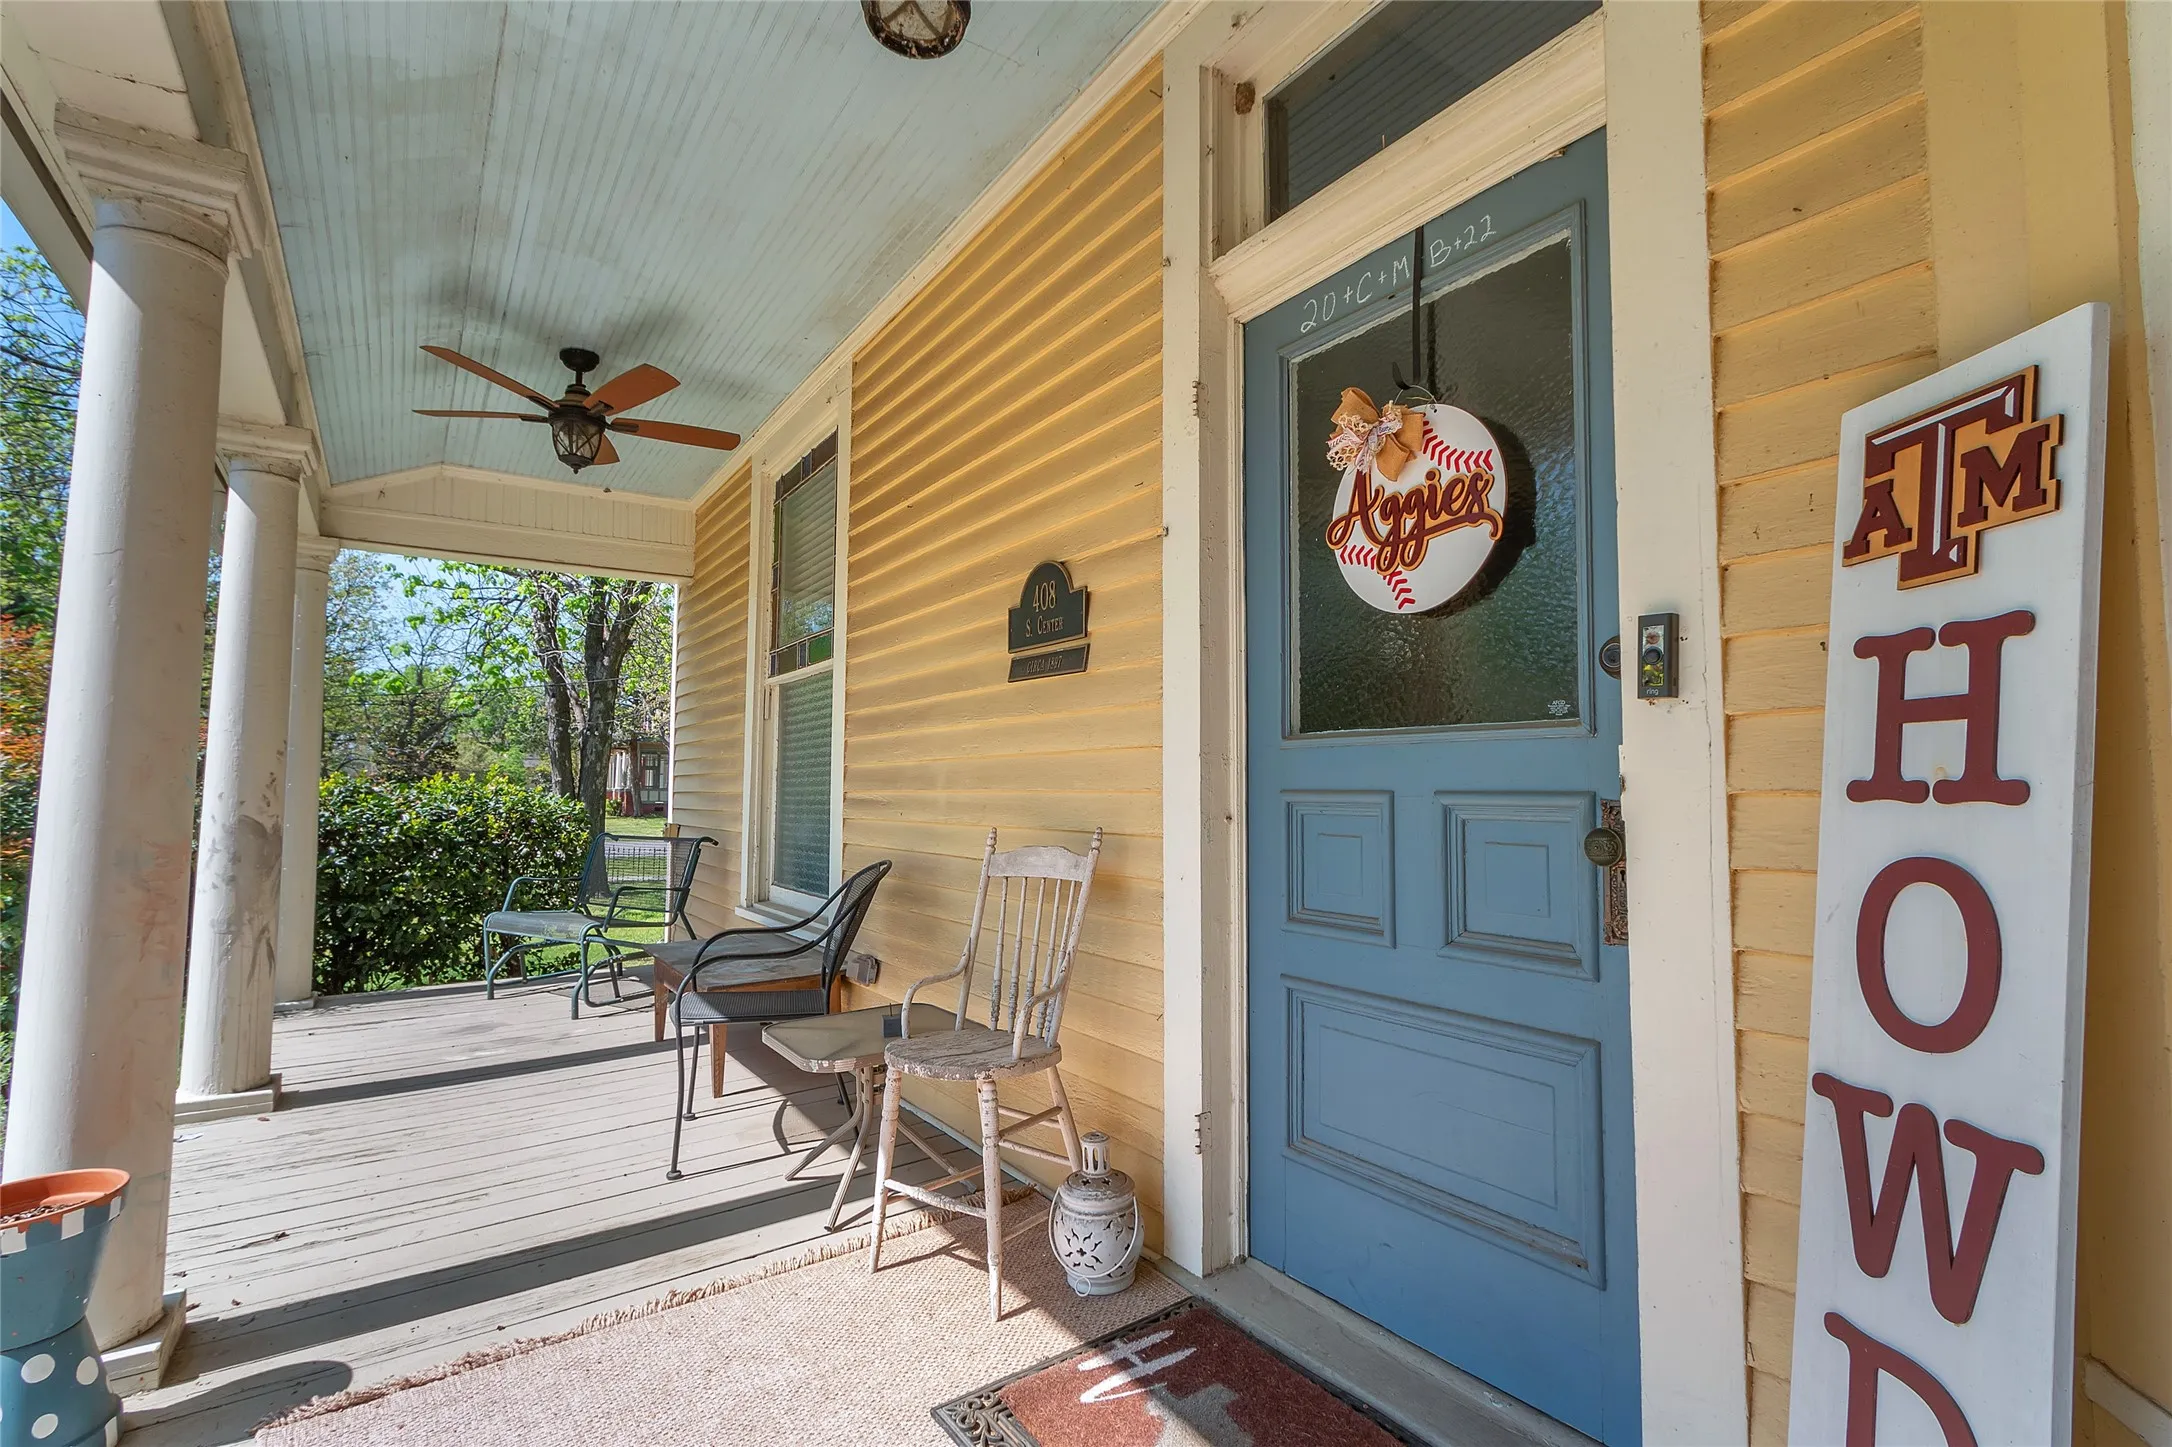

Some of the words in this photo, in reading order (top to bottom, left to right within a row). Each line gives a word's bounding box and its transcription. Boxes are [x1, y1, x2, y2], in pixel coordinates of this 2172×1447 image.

[1326, 467, 1504, 575] Aggies
[1033, 580, 1057, 612] 408
[1025, 619, 1033, 638] S.
[1026, 658, 1045, 674] CIRCA
[1646, 687, 1659, 696] ring
